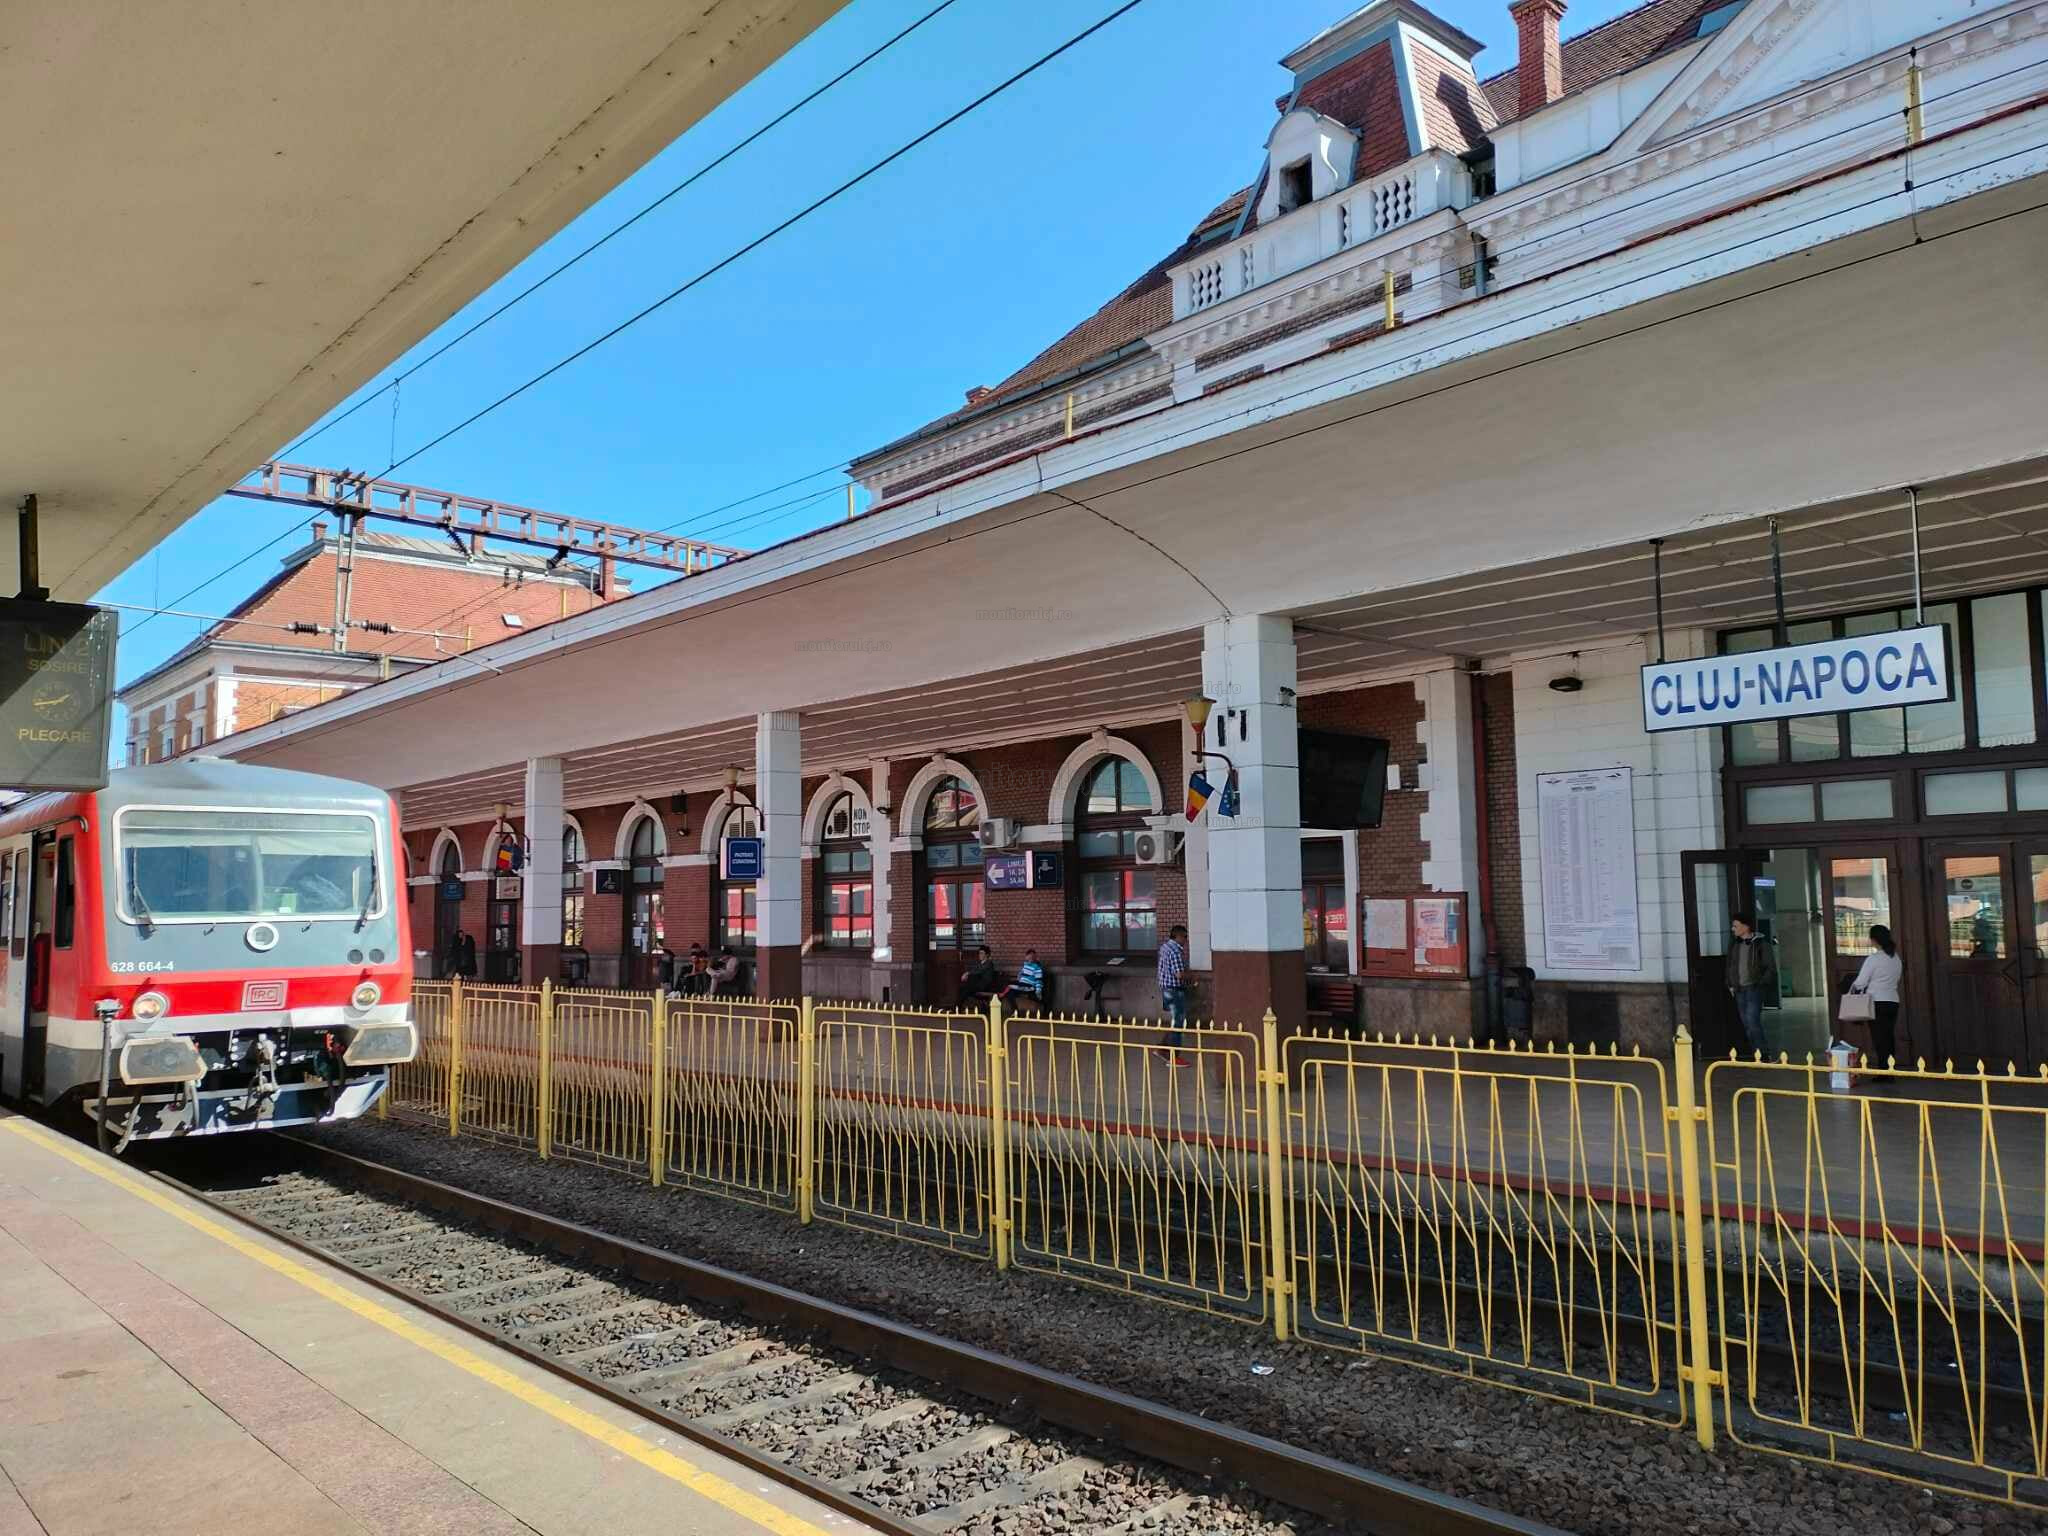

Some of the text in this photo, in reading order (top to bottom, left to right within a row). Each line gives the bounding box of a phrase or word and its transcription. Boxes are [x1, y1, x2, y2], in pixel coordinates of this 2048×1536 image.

[27, 659, 89, 674] SOSIRE
[1650, 642, 1938, 716] CLUJ-NAPOCA
[18, 728, 93, 743] PLECARE
[853, 807, 867, 820] NON
[853, 822, 871, 835] STOP
[111, 960, 174, 973] 628 664-4
